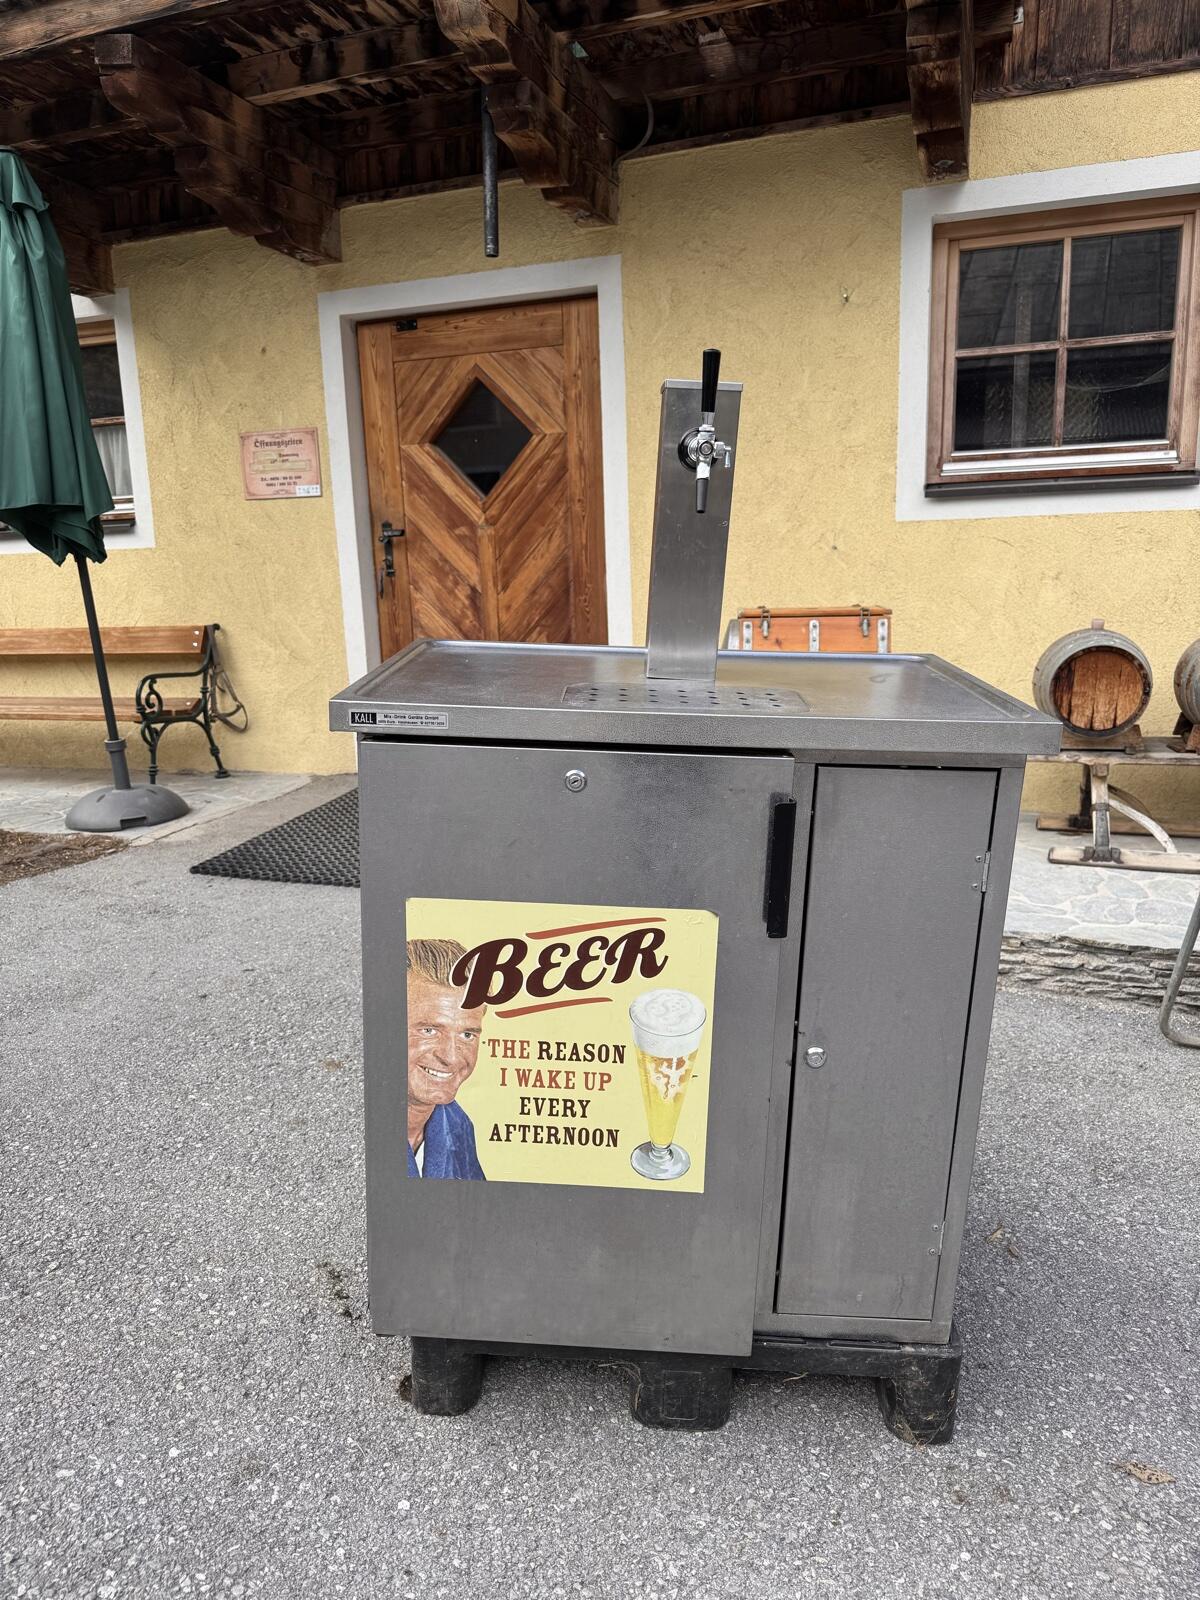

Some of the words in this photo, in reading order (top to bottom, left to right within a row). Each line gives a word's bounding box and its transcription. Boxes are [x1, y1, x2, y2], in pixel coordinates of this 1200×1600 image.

[354, 713, 374, 723] KALL
[451, 928, 669, 1010] BEER
[488, 1038, 531, 1060] THE
[537, 1040, 627, 1064] REASON
[499, 1068, 508, 1087] I
[514, 1068, 577, 1090] WAKE
[584, 1072, 613, 1091] UP
[519, 1096, 592, 1118] EVERY
[488, 1123, 621, 1148] AFTERNOON
